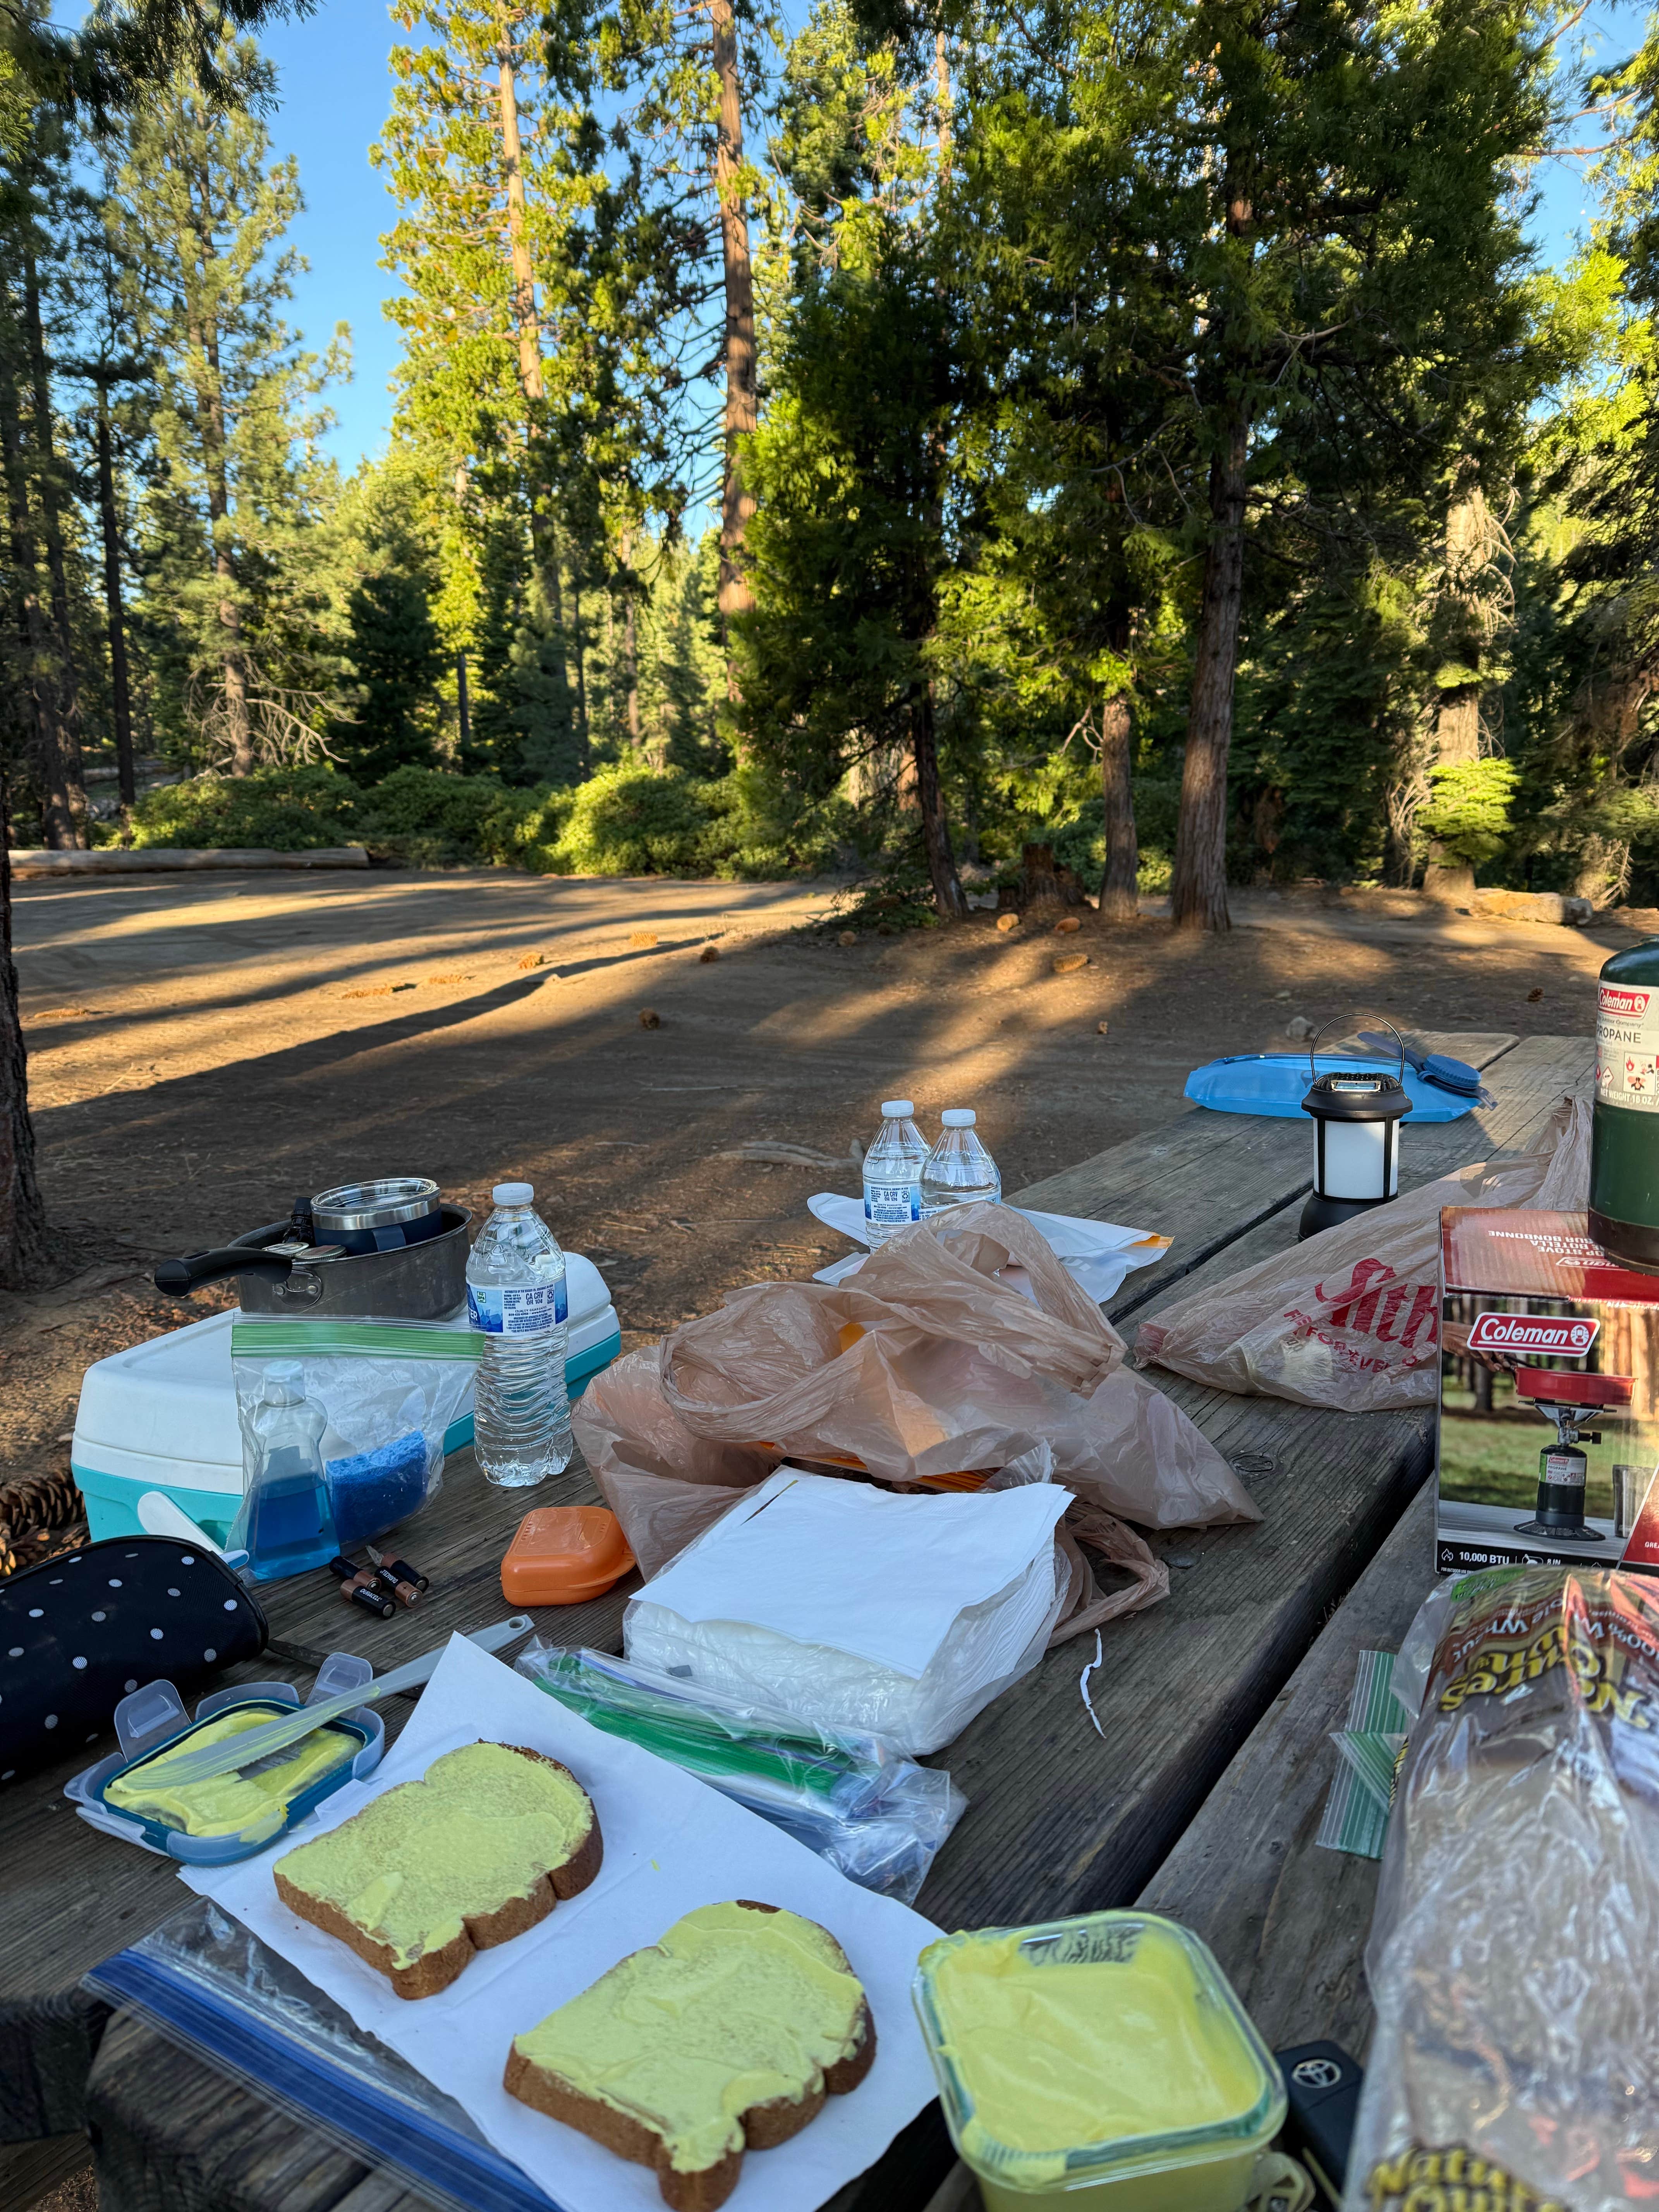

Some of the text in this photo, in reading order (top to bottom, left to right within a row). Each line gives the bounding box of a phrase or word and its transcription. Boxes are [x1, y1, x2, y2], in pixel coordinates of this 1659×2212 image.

[1600, 989, 1633, 1010] Coleman
[1609, 1090, 1631, 1102] WEIGHT
[1488, 1230, 1561, 1242] BONBONNE
[1530, 1239, 1589, 1250] BOTELLA
[1538, 1246, 1582, 1255] STOVE
[534, 1291, 543, 1299] CRV
[1480, 1318, 1569, 1345] Coleman
[1459, 1551, 1510, 1565] 10,000 BTU
